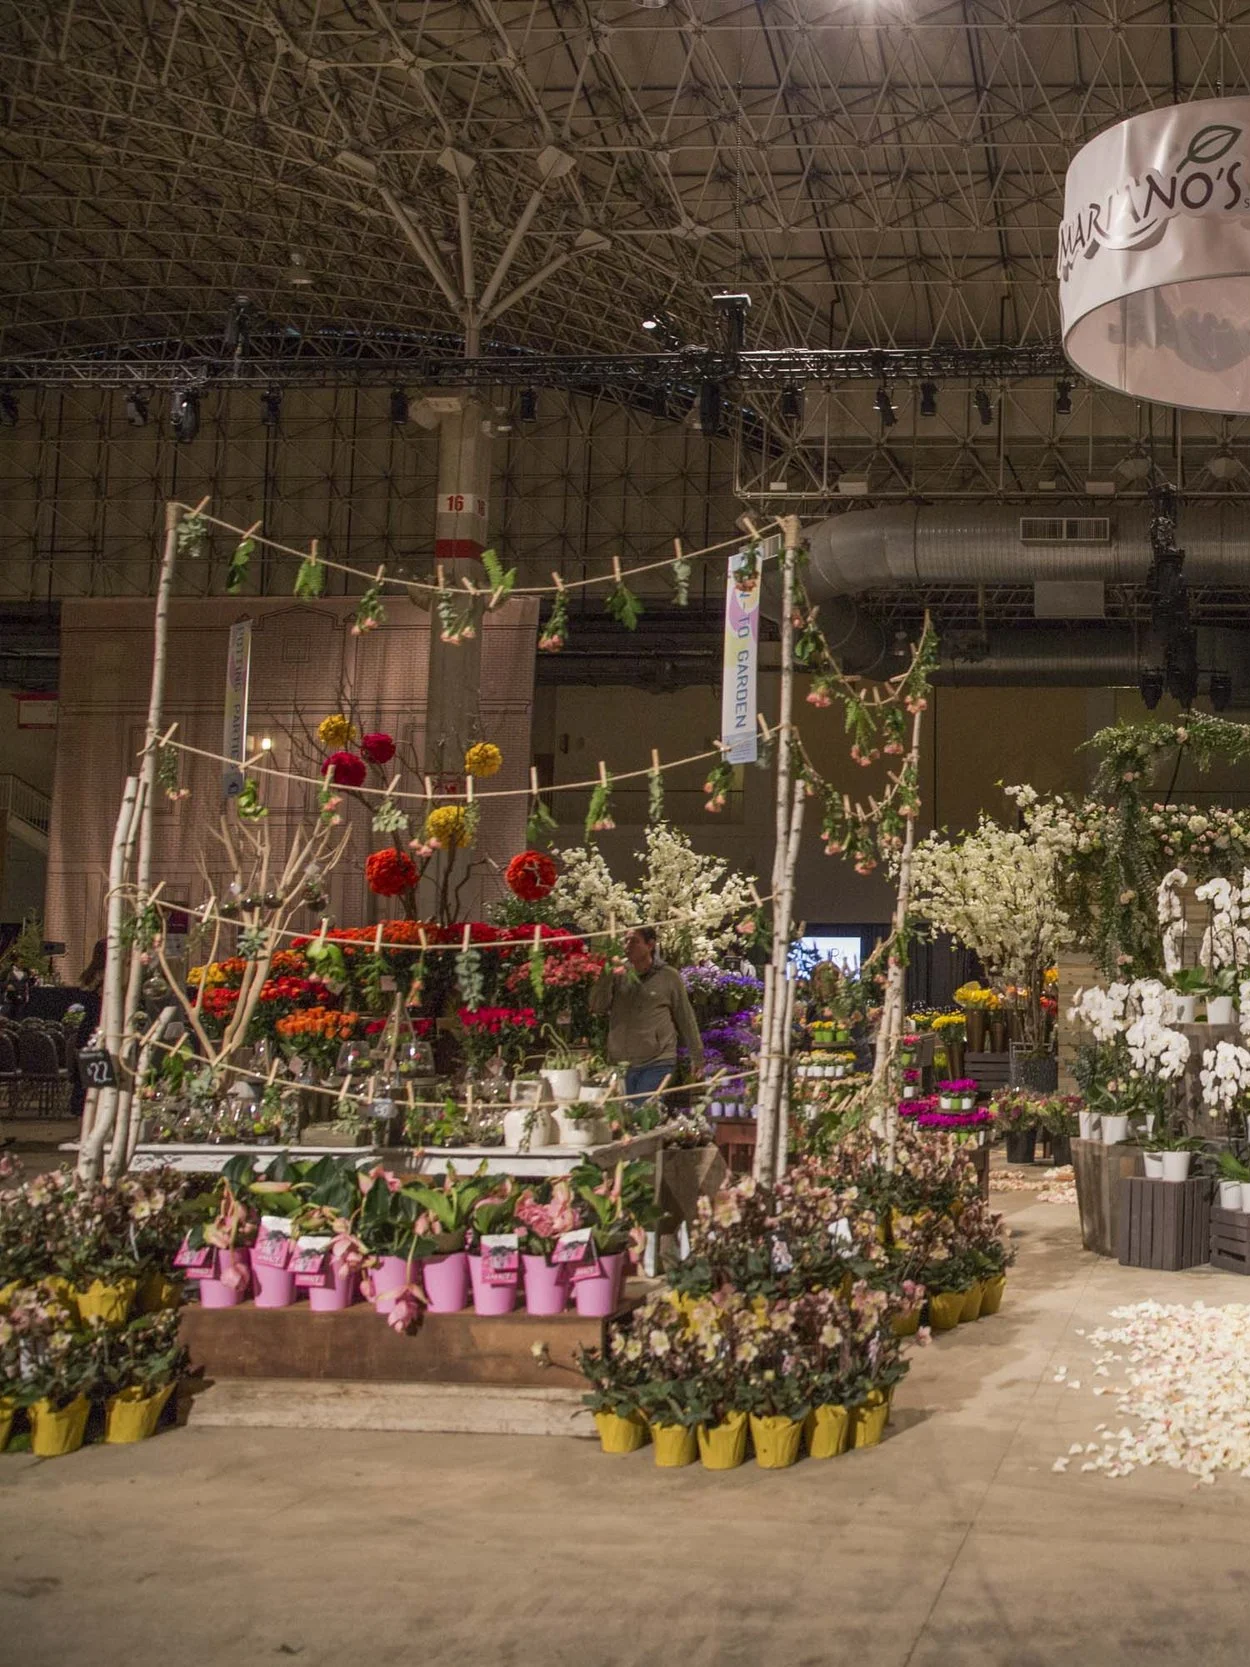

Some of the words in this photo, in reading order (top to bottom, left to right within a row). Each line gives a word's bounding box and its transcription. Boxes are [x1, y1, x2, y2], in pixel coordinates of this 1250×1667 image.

[1058, 161, 1241, 271] MARIANO'S
[447, 495, 465, 512] 16
[735, 649, 749, 729] GARDEN
